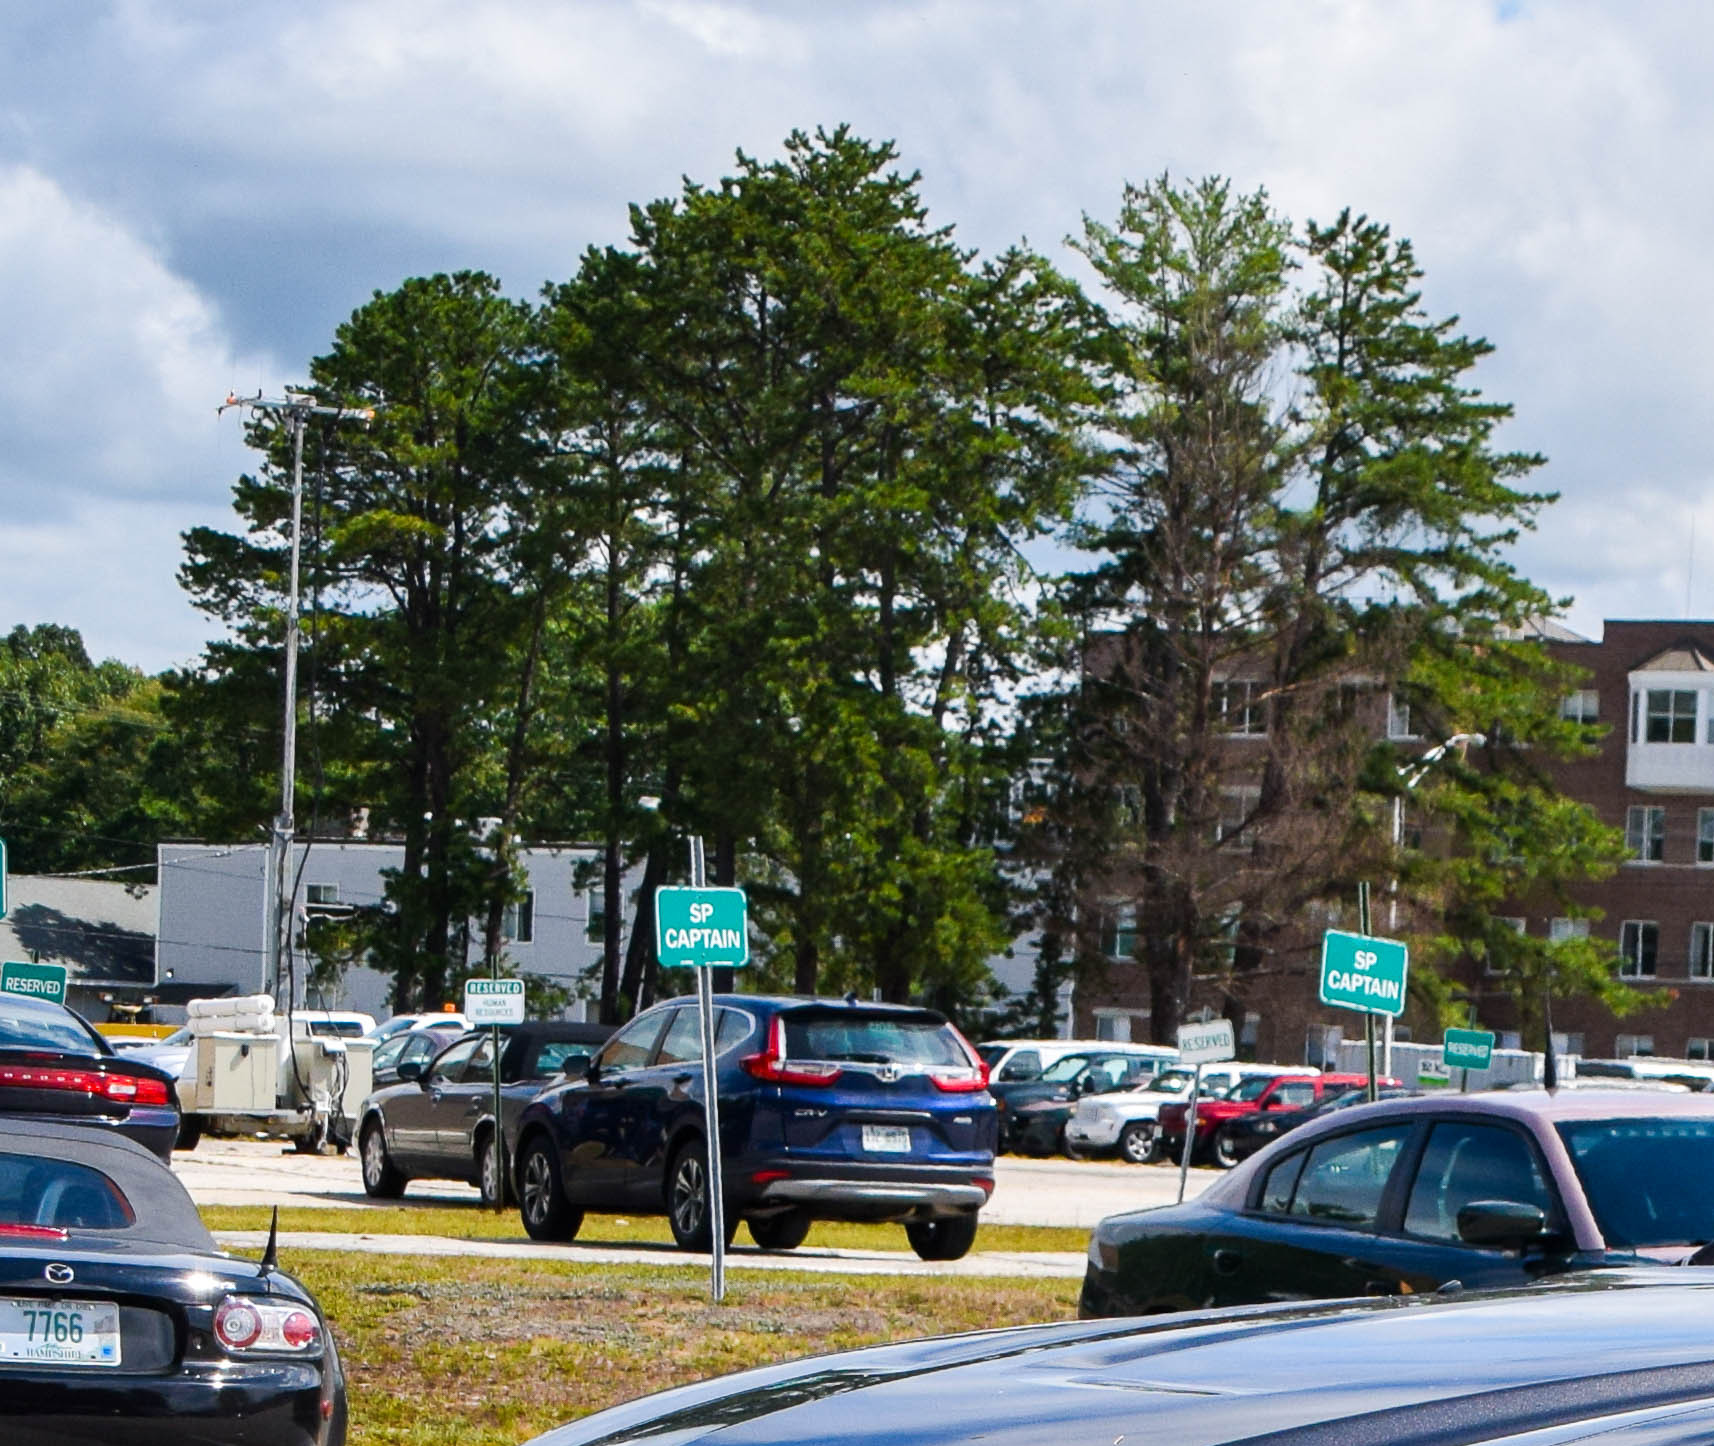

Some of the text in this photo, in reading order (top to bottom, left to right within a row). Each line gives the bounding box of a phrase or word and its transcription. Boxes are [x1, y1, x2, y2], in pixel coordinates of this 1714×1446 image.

[689, 902, 714, 923] SP
[664, 928, 741, 949] CAPTAIN
[1353, 949, 1378, 972] SP
[5, 977, 61, 995] RESERVED
[469, 983, 520, 994] RESERVED
[1327, 969, 1399, 1000] CAPTAIN
[1181, 1031, 1231, 1052] RESERVED
[23, 1310, 83, 1344] 7766
